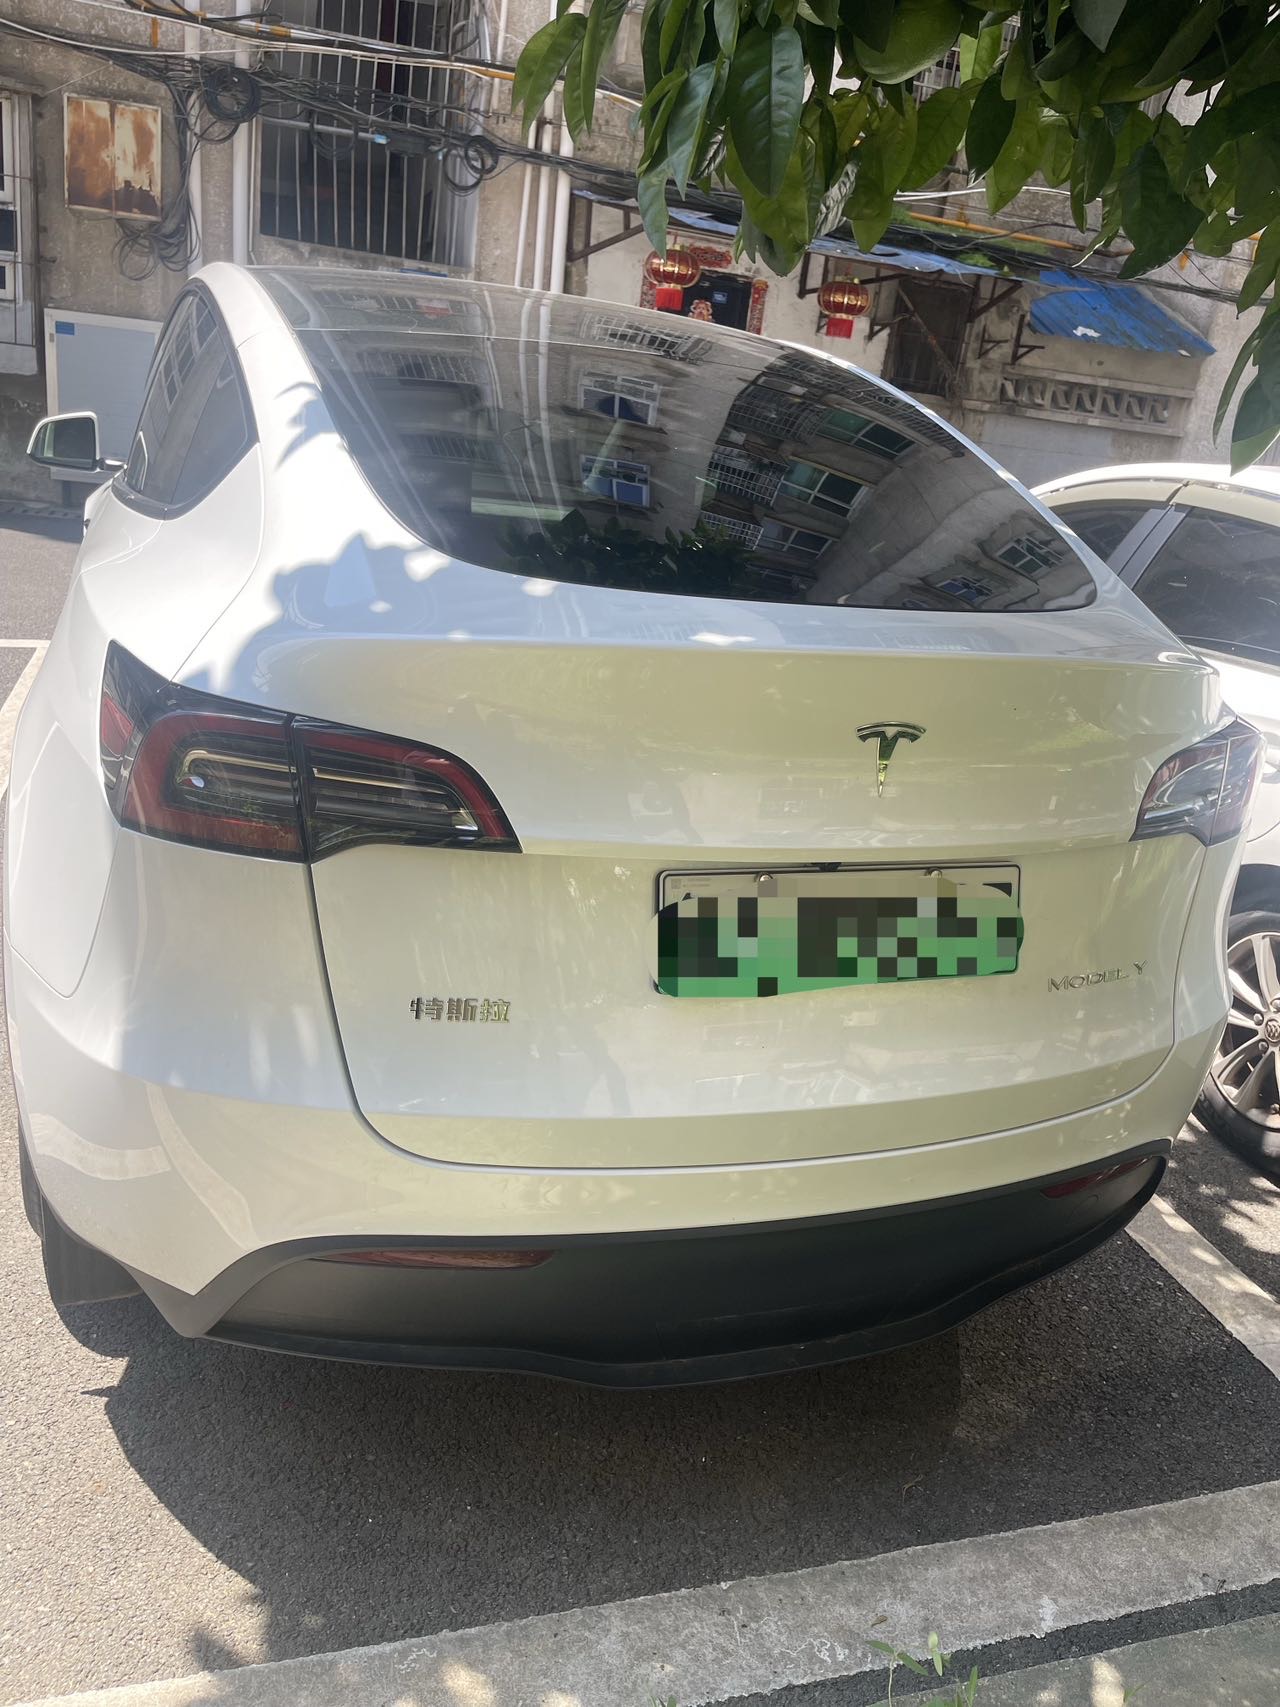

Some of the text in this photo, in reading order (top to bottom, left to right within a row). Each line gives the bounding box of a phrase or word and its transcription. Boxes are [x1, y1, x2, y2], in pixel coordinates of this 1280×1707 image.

[1047, 959, 1148, 992] MODEL Y
[409, 997, 511, 1022] 特斯拉
